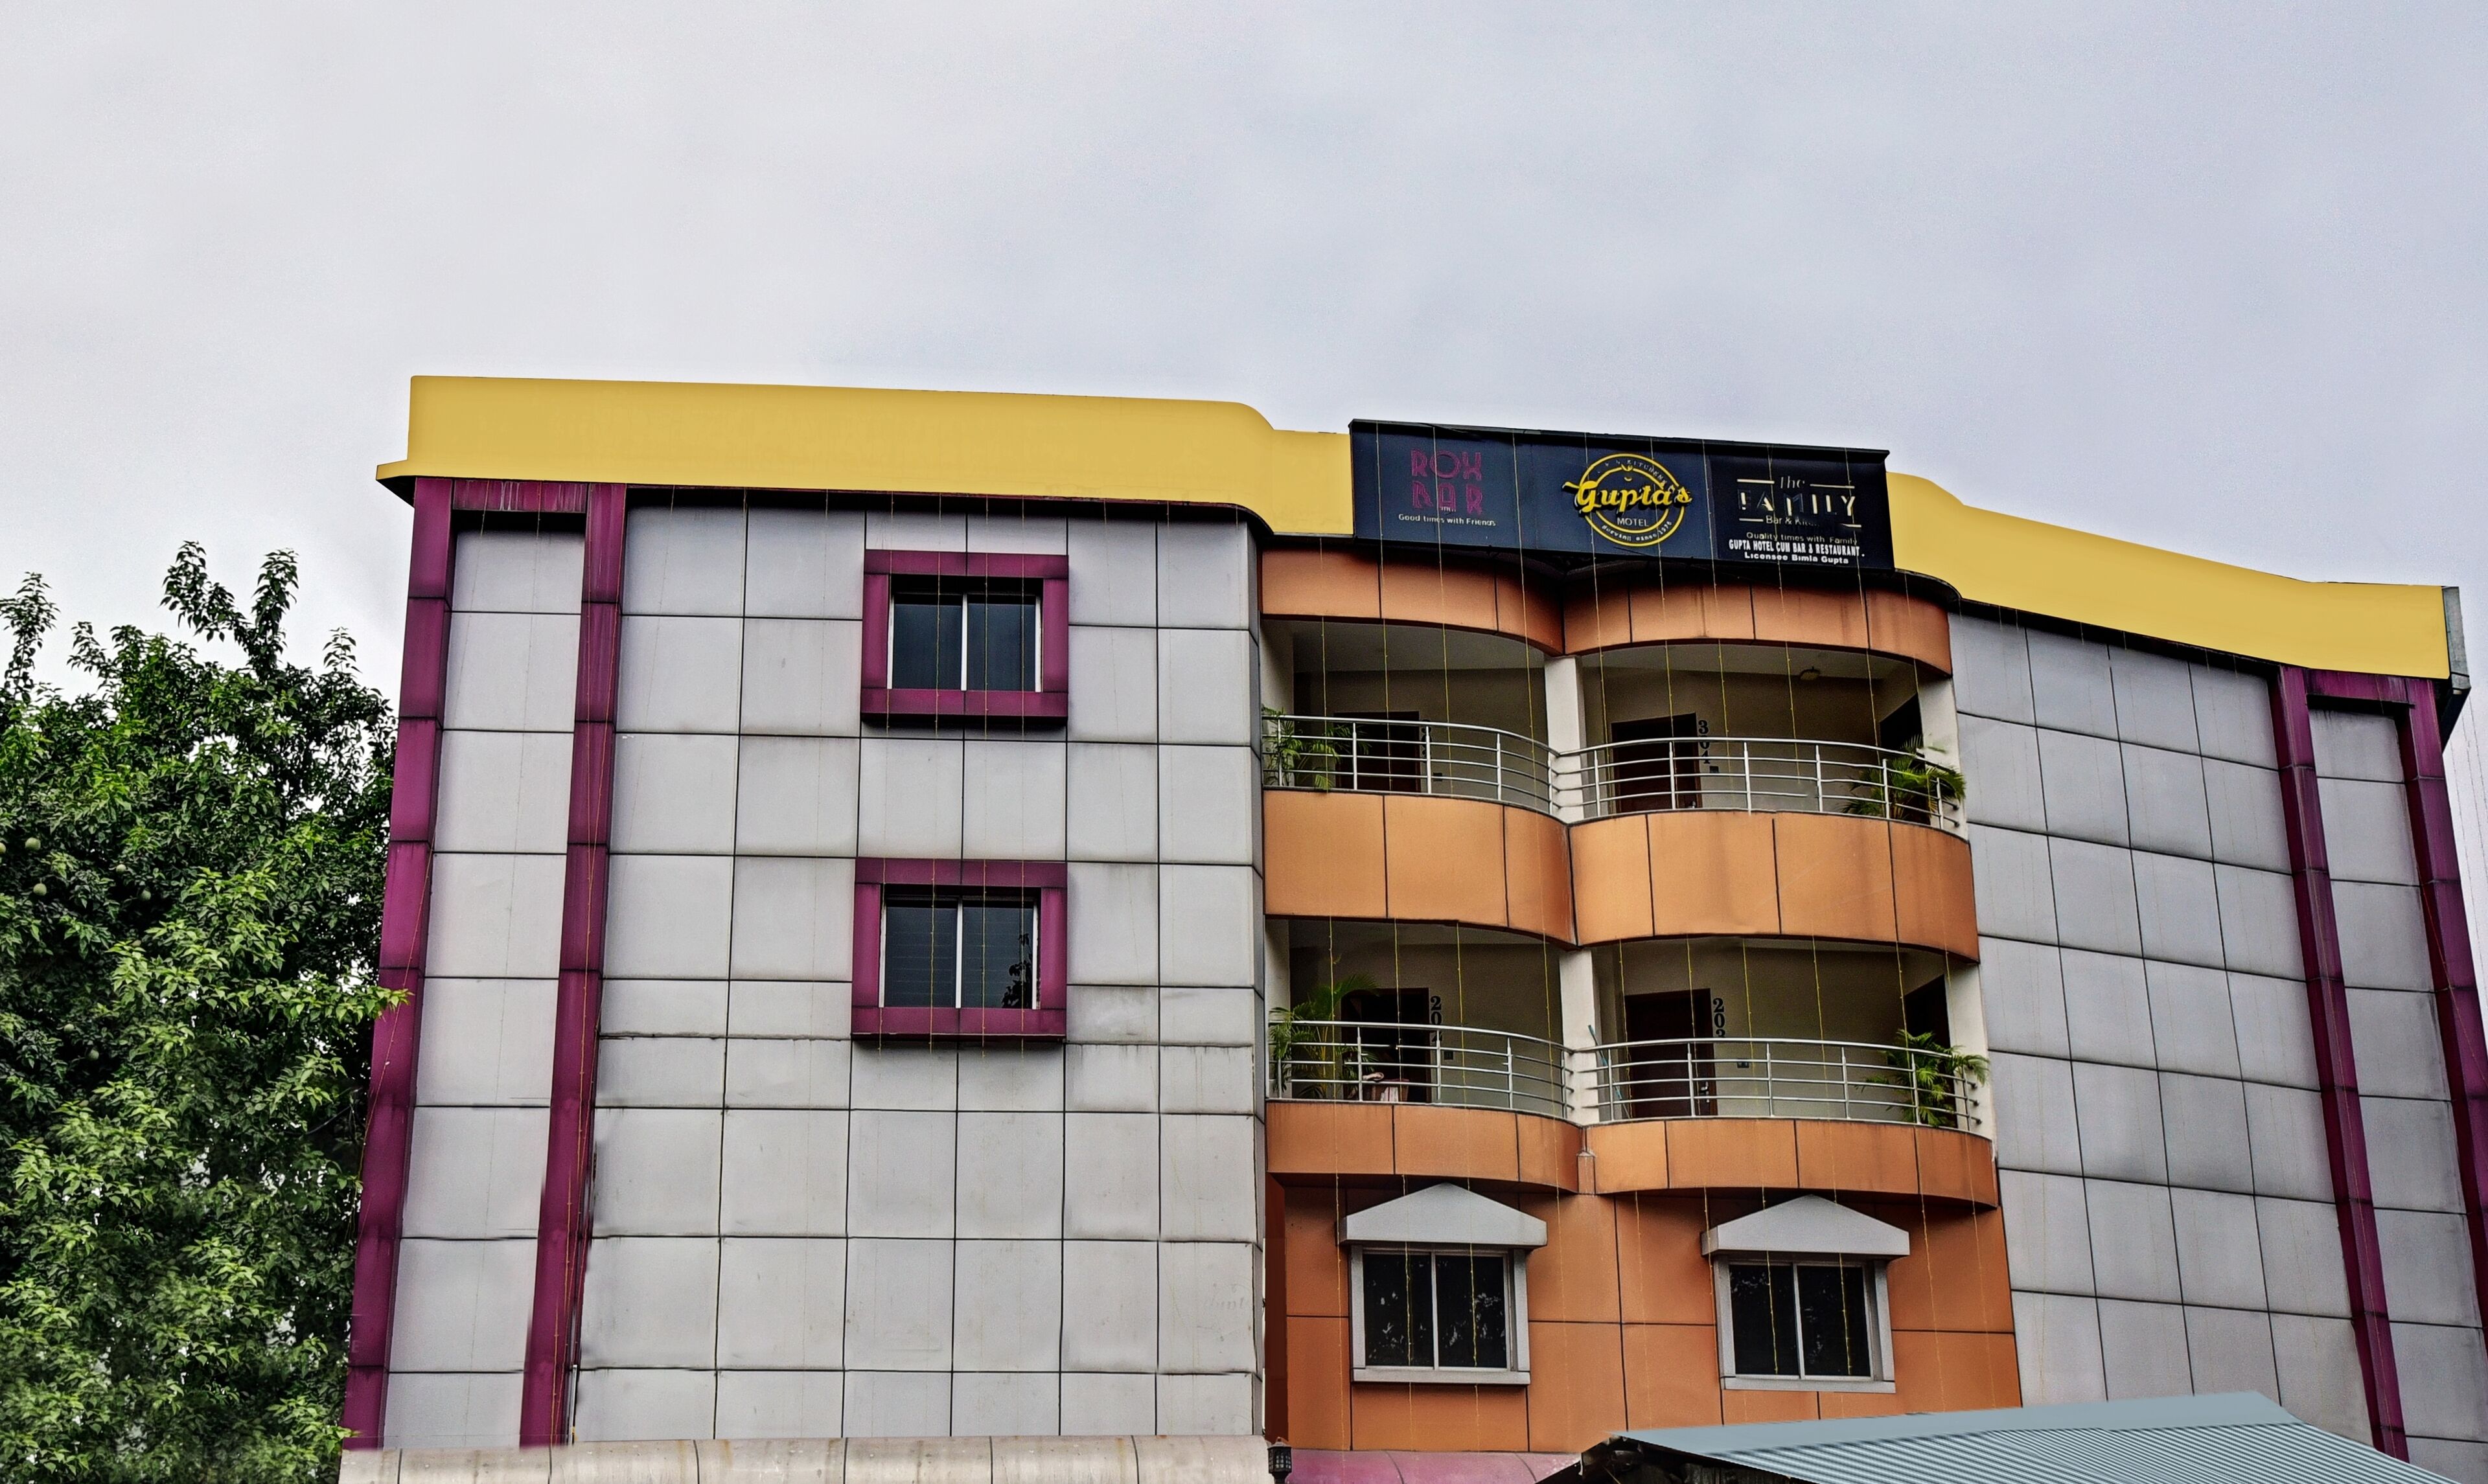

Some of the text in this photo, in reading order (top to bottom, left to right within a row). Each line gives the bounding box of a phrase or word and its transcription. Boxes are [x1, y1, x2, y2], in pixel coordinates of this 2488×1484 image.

[1562, 480, 1692, 514] Gupta's
[1466, 518, 1496, 527] Friends
[1617, 518, 1650, 527] MOTEL
[1766, 516, 1782, 525] Bar
[1729, 539, 1751, 551] GUPTA
[1753, 540, 1775, 551] HOTEL
[1776, 542, 1790, 553] CUM
[1793, 543, 1806, 553] BAR
[1746, 532, 1778, 542] Quality
[1806, 534, 1825, 543] with
[1830, 537, 1858, 546] Family
[1744, 551, 1849, 565] Licensee Bimla Gupta
